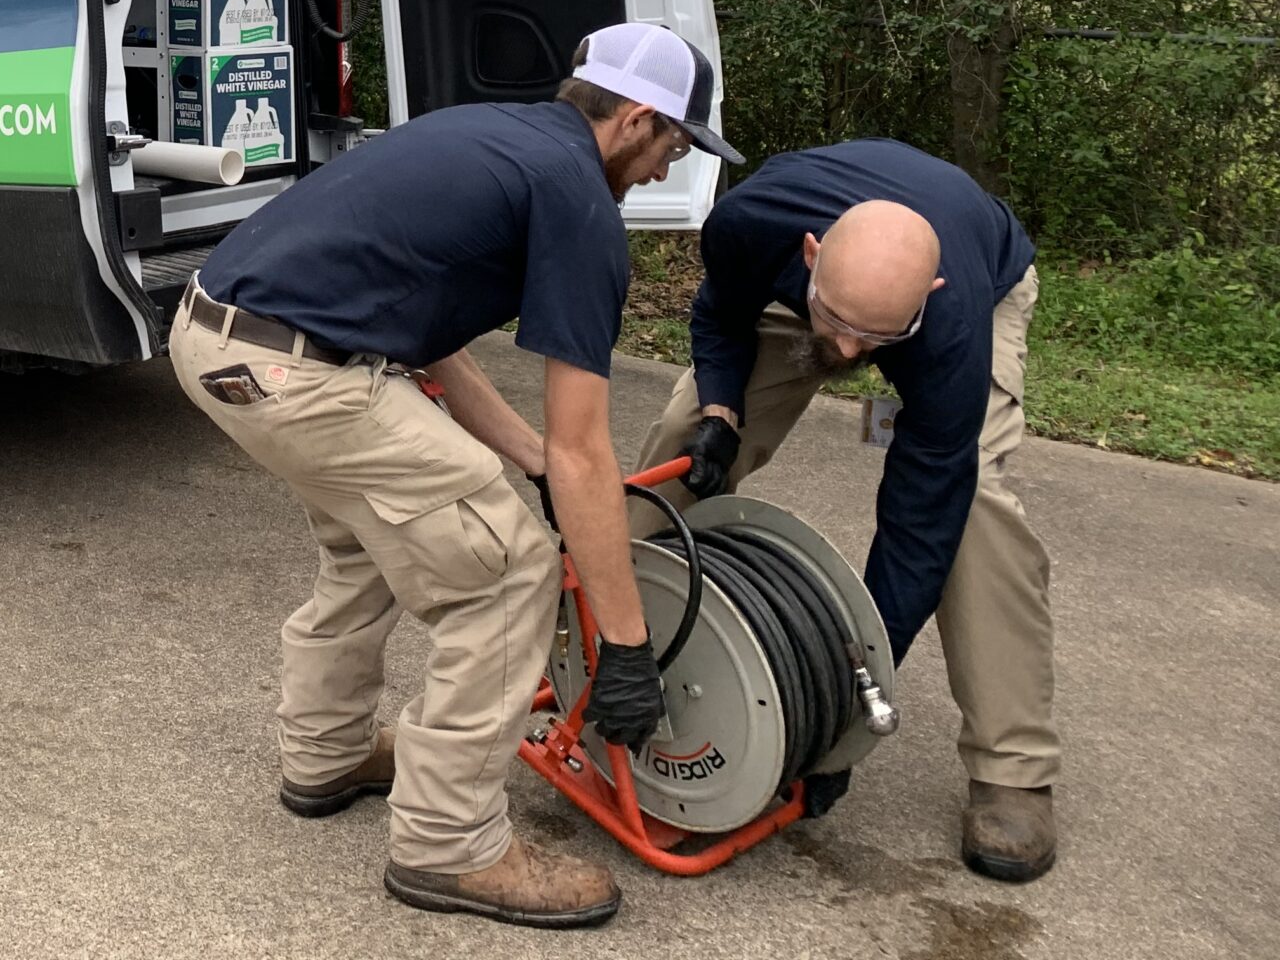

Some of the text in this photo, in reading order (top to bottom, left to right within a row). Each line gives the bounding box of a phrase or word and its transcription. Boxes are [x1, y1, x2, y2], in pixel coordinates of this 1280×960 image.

[171, 0, 199, 8] VINEGAR
[211, 58, 218, 67] 2
[228, 70, 272, 82] DISTILLED
[216, 79, 286, 93] WHITE VINEGAR
[175, 102, 202, 111] DISTILLED
[180, 111, 198, 119] WHITE
[176, 119, 201, 128] VINEGAR
[653, 747, 726, 780] RIDGID
